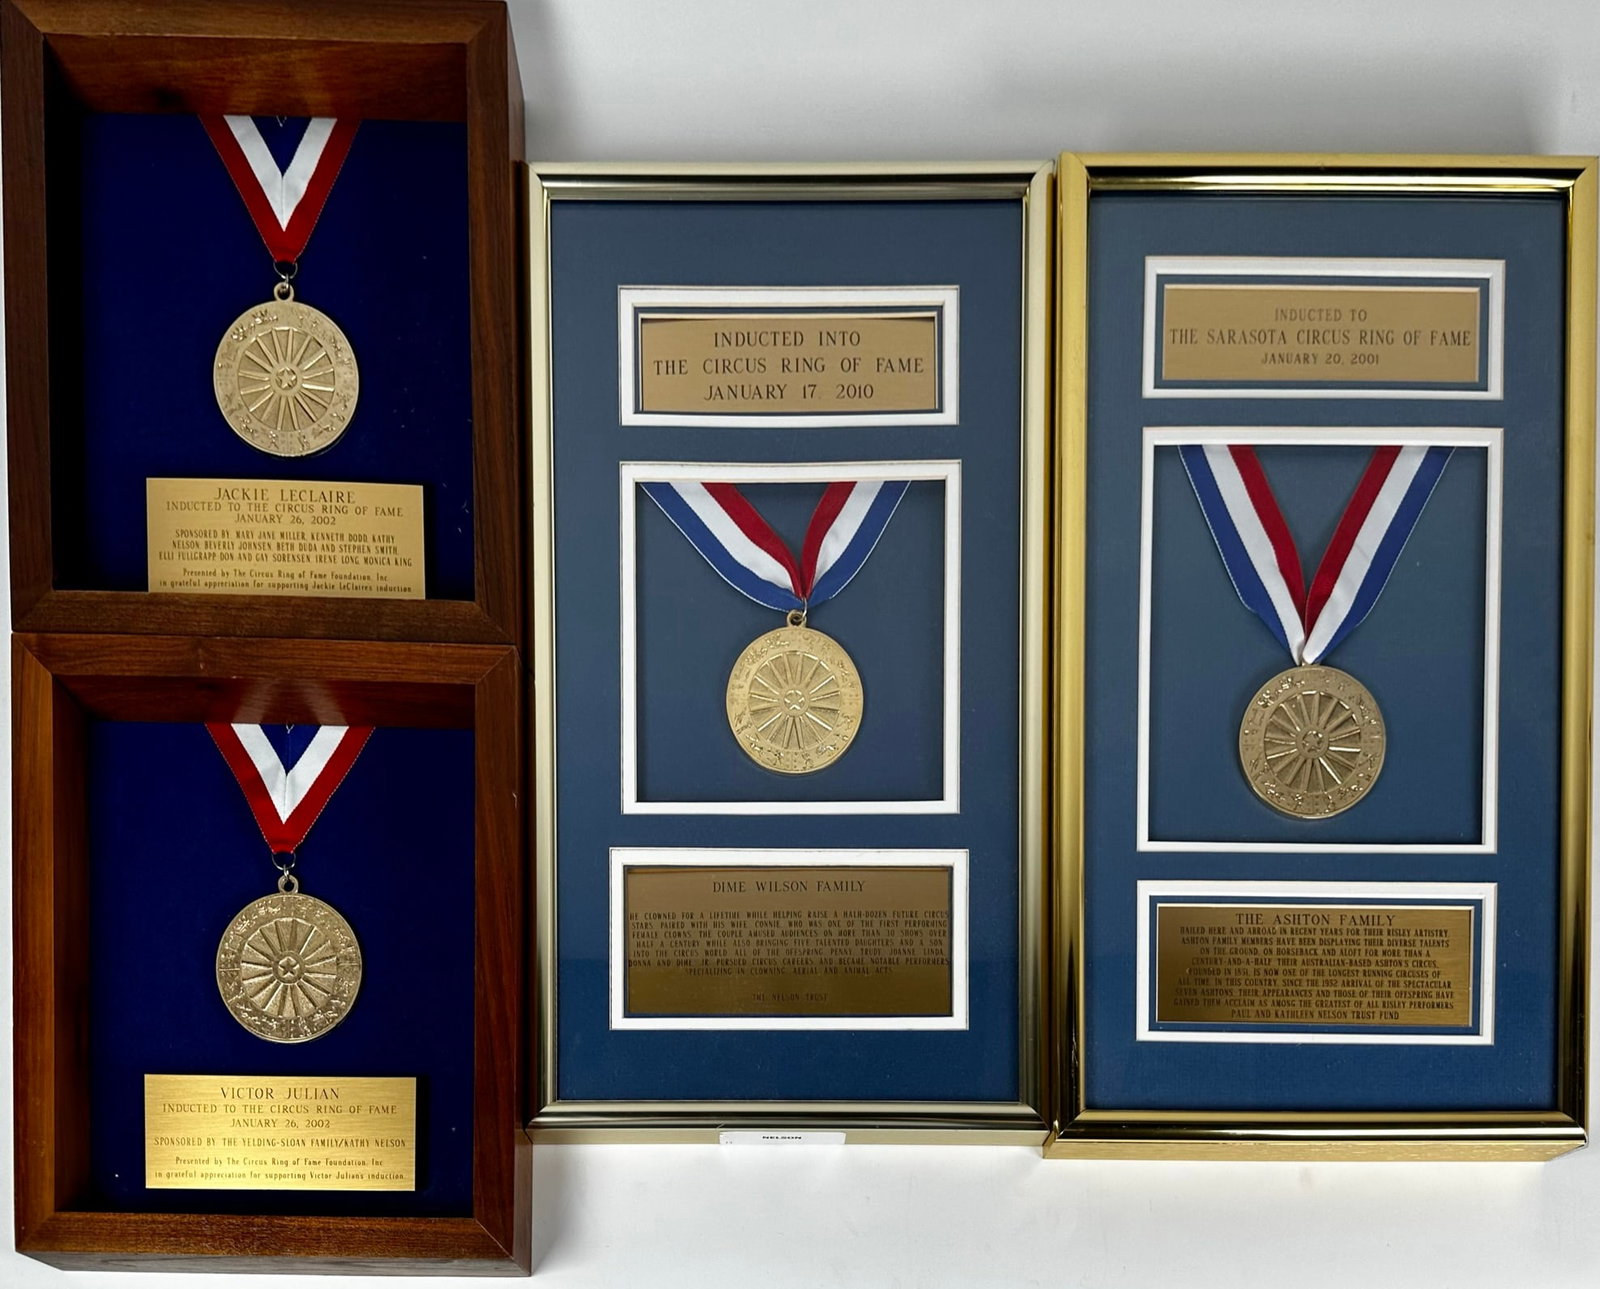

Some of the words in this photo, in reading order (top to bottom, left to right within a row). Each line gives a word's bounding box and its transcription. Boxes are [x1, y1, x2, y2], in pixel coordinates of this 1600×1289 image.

[1275, 308, 1343, 322] INDUCTED
[1349, 309, 1368, 322] TO
[715, 332, 804, 348] INDUCTED
[820, 331, 861, 346] INTO
[1170, 329, 1198, 344] THE
[1207, 329, 1287, 345] SARASOTA
[1297, 330, 1350, 345] CIRCUS
[1360, 330, 1394, 345] RING
[1404, 331, 1421, 345] OF
[1431, 331, 1472, 345] FAME
[1262, 353, 1318, 364] JANUARY
[1351, 354, 1380, 364] 2001
[653, 360, 688, 375] THE
[703, 359, 766, 374] CIRCUS
[782, 359, 825, 374] RING
[841, 358, 861, 373] OF
[877, 358, 924, 373] FAME
[704, 385, 787, 400] JANUARY
[837, 384, 874, 399] 2010
[215, 488, 269, 501] JACKIE
[281, 489, 356, 504] LECLAIRE
[167, 502, 222, 512] INDUCTED
[228, 503, 241, 512] TO
[249, 503, 268, 513] THE
[275, 504, 314, 514] CIRCUS
[322, 505, 349, 516] RING
[354, 506, 368, 516] OF
[375, 506, 404, 517] FAME
[235, 514, 283, 524] JANUARY
[290, 515, 304, 525] 26,
[311, 516, 337, 525] 2002
[321, 544, 336, 553] AND
[238, 553, 252, 562] AND
[183, 568, 217, 577] Presented
[221, 569, 230, 579] by
[234, 570, 246, 578] The
[250, 570, 274, 578] Circus
[298, 571, 306, 579] of
[310, 571, 327, 580] Fame
[171, 579, 200, 589] grateful
[713, 881, 746, 893] DIME
[755, 881, 808, 893] WILSON
[817, 881, 865, 892] FAMILY
[1236, 914, 1264, 924] THE
[1274, 914, 1330, 925] ASHTON
[1340, 914, 1396, 926] FAMILY
[1256, 1010, 1271, 1018] AND
[1318, 1011, 1348, 1019] NELSON
[1351, 1011, 1376, 1019] TRUST
[221, 1087, 274, 1099] VICTOR
[286, 1088, 339, 1099] JULIAN
[163, 1104, 217, 1113] INDUCTED
[224, 1104, 236, 1113] TO
[243, 1104, 264, 1113] THE
[270, 1105, 309, 1114] CIRCUS
[316, 1105, 343, 1114] RING
[349, 1105, 362, 1114] OF
[369, 1105, 397, 1114] FAME
[231, 1119, 278, 1128] JANUARY
[305, 1119, 330, 1128] 2002
[154, 1137, 202, 1146] SPONSORED
[207, 1138, 215, 1146] BY
[223, 1138, 237, 1146] THE
[375, 1138, 406, 1147] NELSON
[176, 1157, 210, 1165] Presented
[214, 1157, 222, 1167] by
[272, 1158, 288, 1167] Ring
[166, 1171, 196, 1180] grateful
[201, 1171, 246, 1180] appreciation
[266, 1171, 306, 1180] supporting
